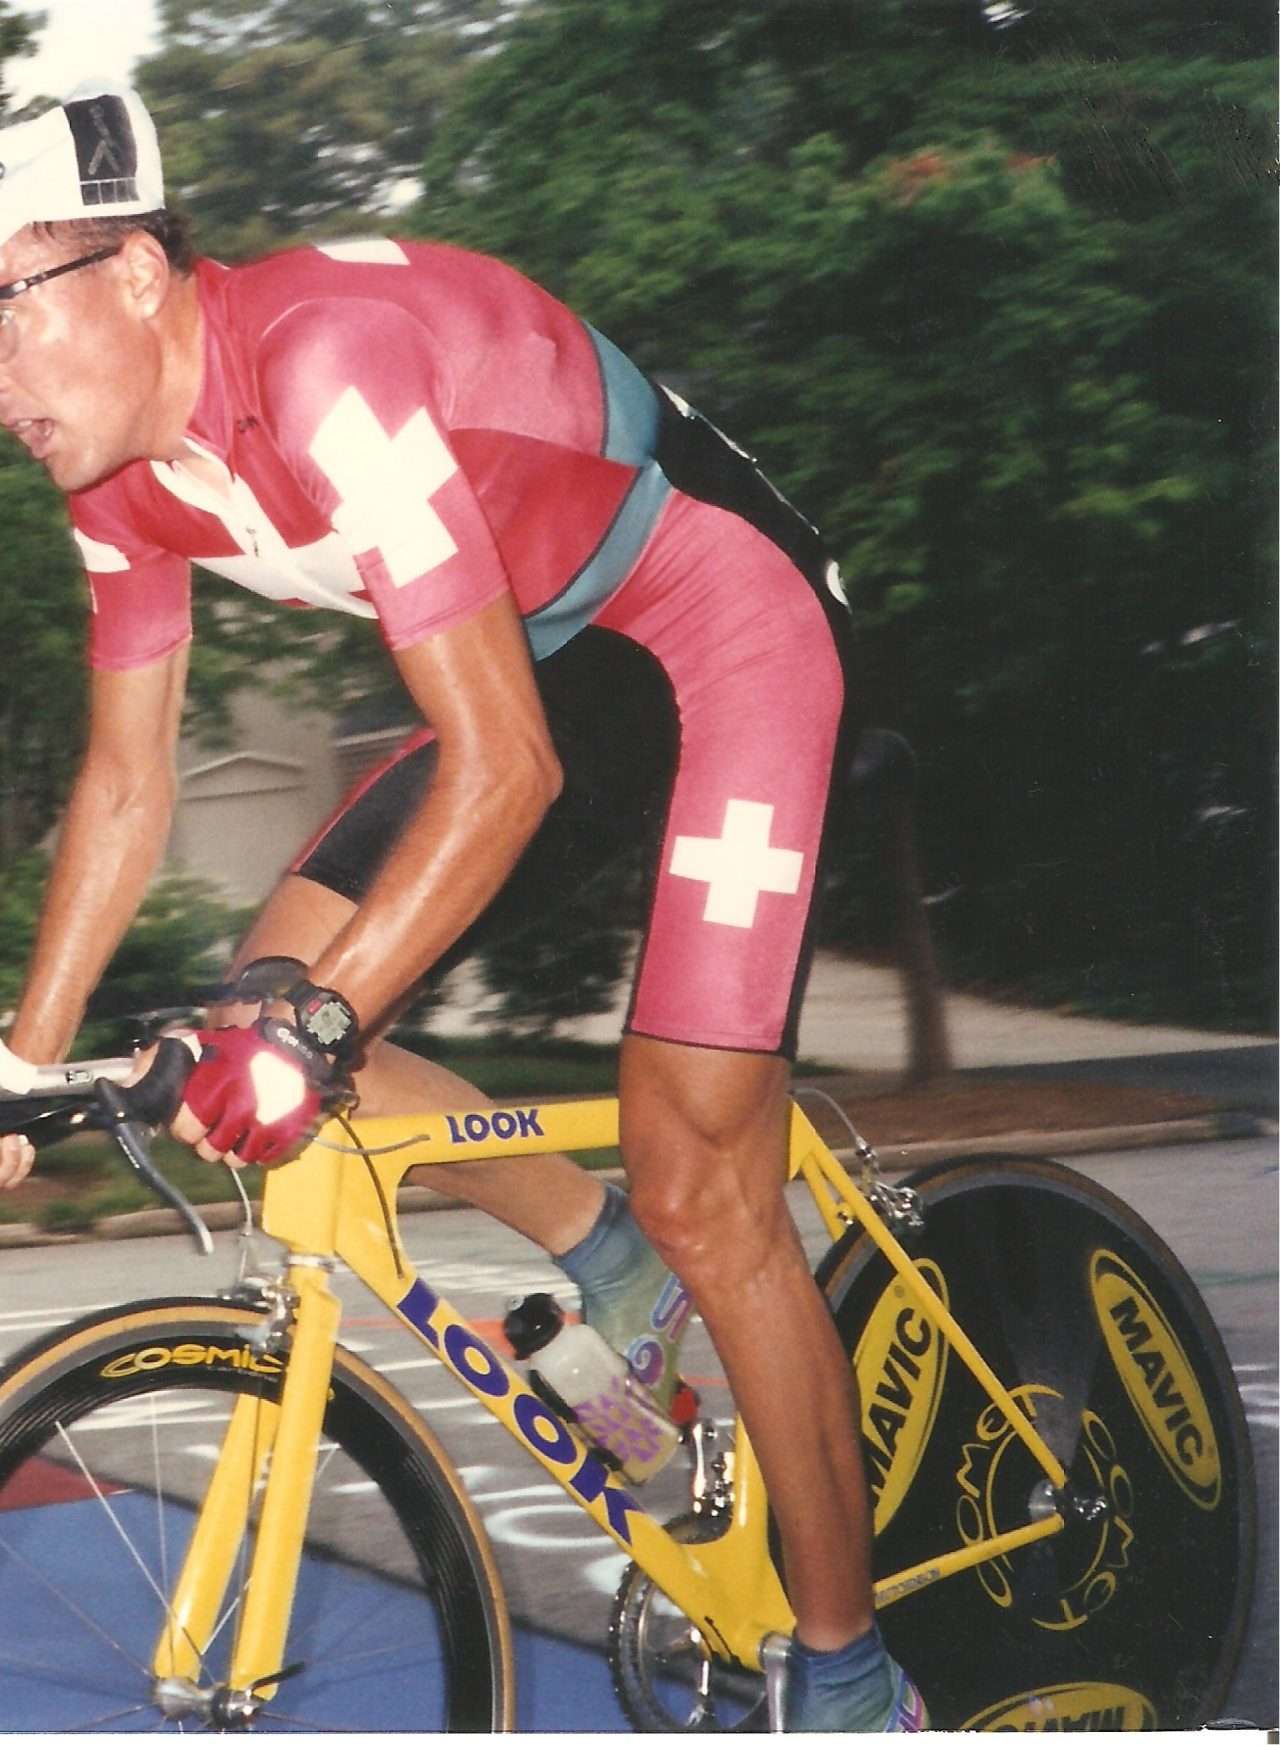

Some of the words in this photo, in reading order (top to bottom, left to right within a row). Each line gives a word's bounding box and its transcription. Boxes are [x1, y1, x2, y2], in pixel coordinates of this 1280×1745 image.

[445, 1107, 545, 1143] LOOK
[396, 1277, 644, 1547] LOOK
[1109, 1296, 1203, 1466] MAVIC
